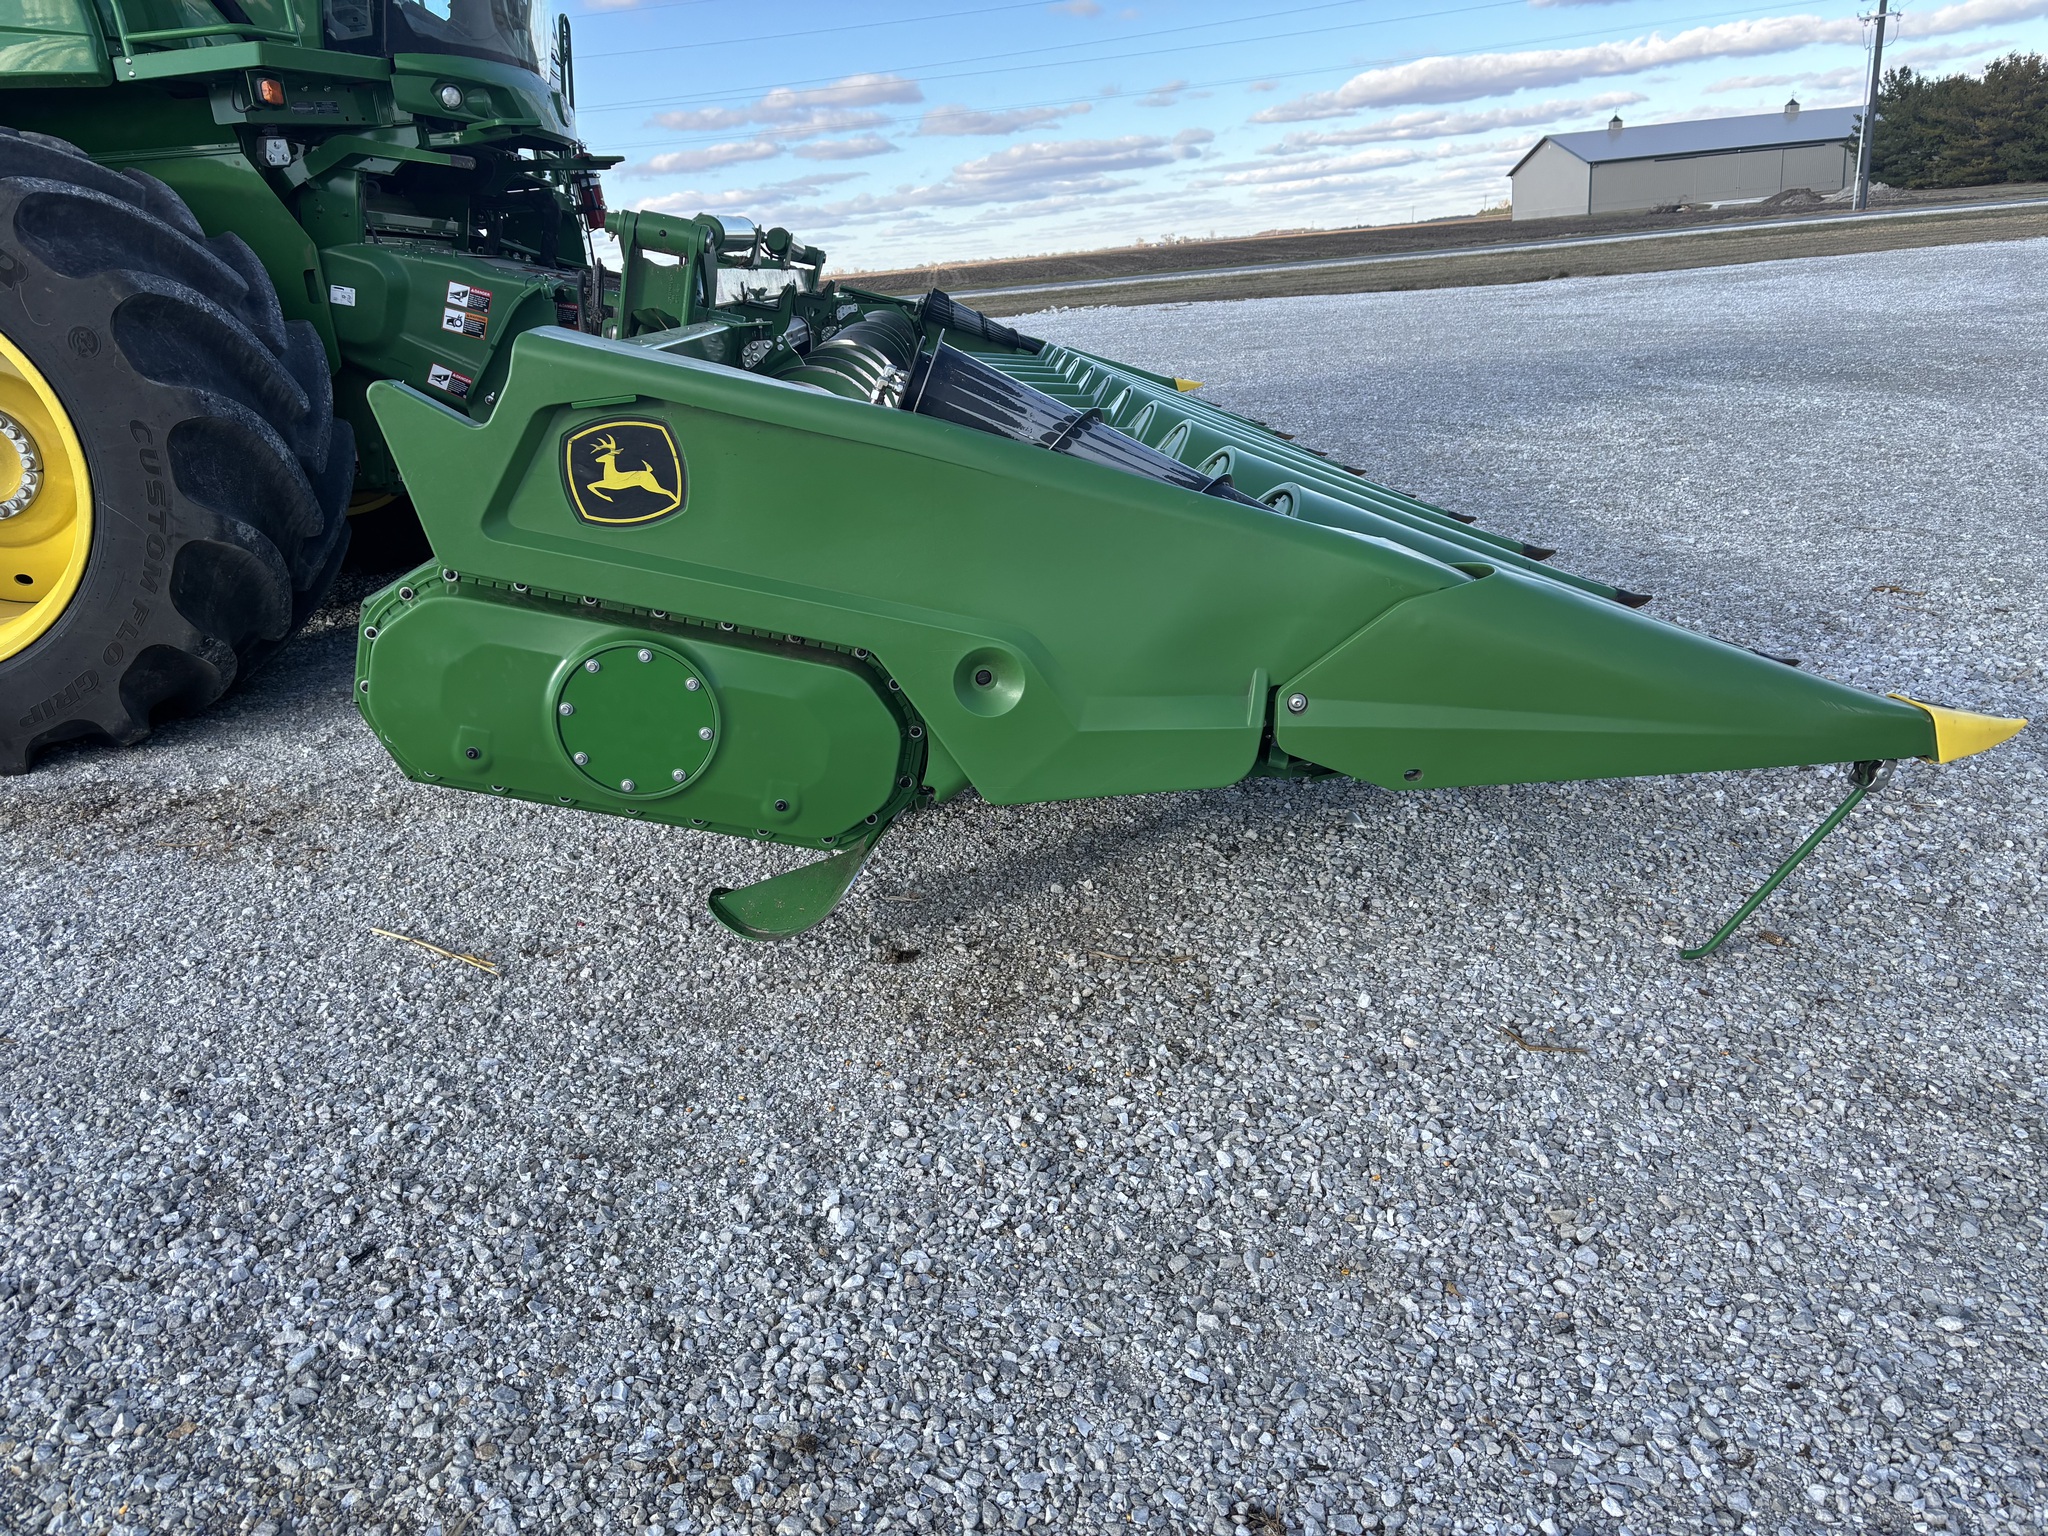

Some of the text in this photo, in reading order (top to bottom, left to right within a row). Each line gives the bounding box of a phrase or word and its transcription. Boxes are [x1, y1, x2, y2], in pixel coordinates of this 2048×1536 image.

[19, 419, 167, 728] CUSTOM FLO GRIP
